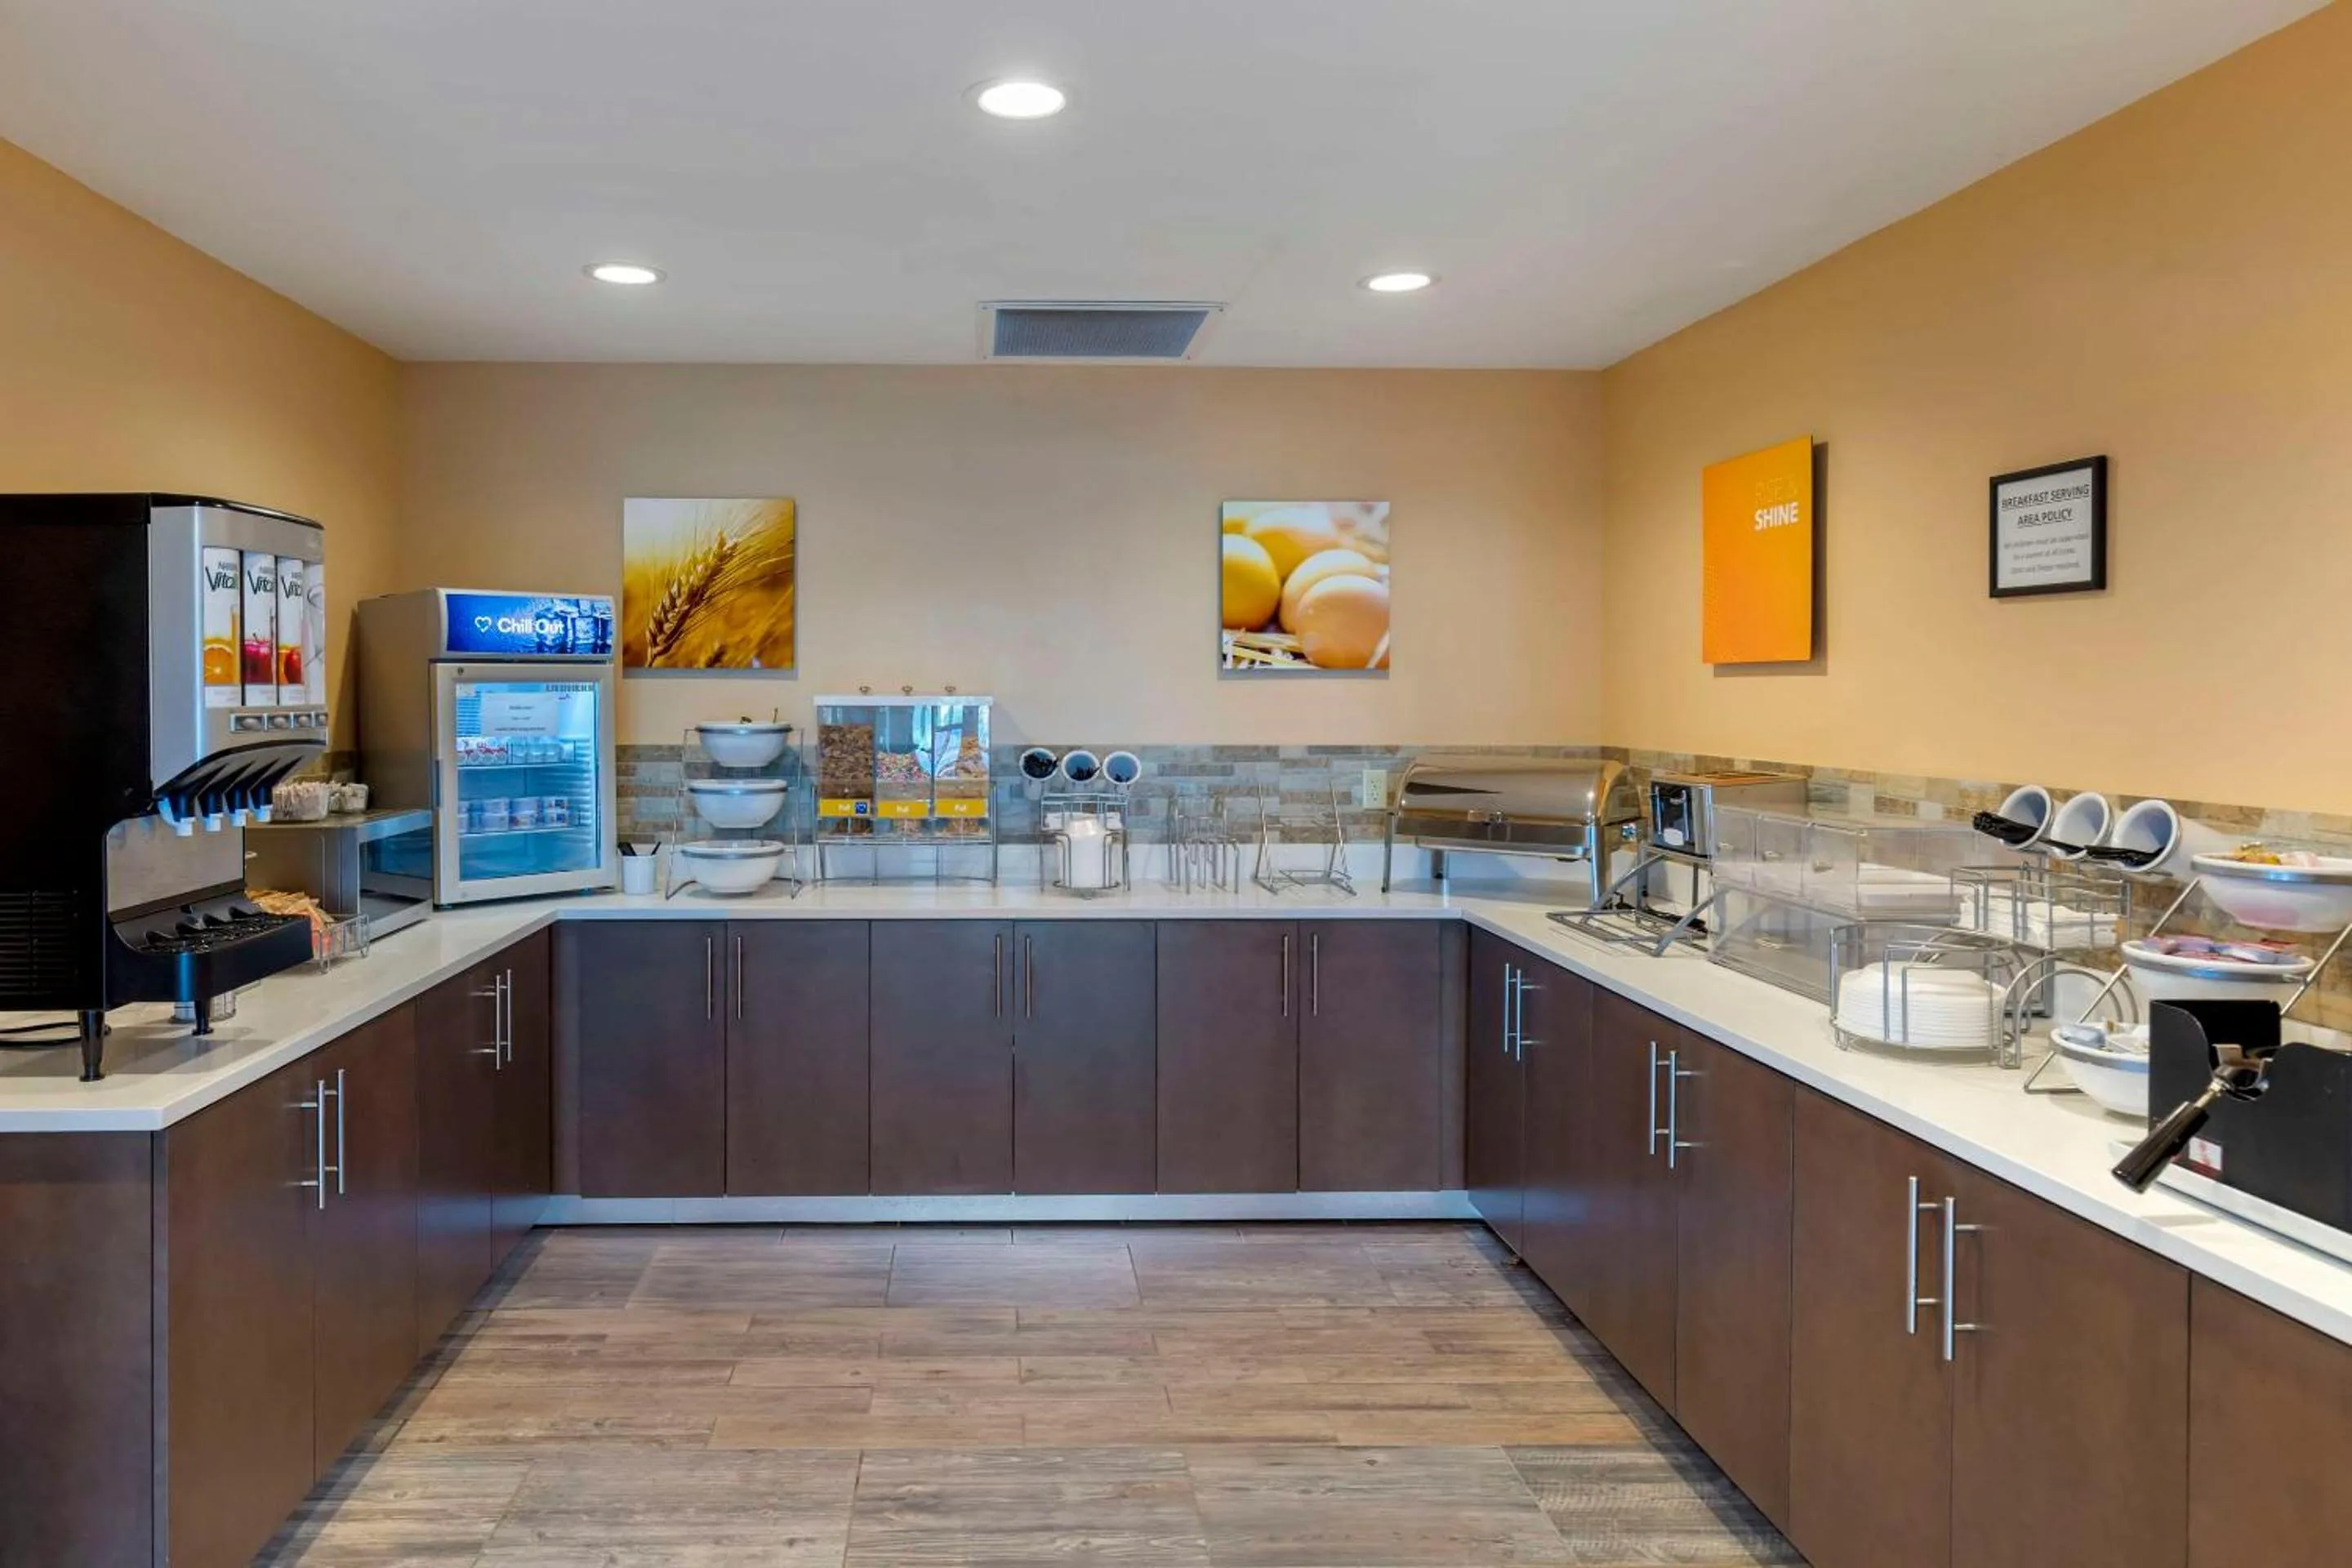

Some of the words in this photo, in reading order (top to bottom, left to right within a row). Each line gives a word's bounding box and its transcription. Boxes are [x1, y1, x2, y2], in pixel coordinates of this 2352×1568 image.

[2002, 491, 2049, 508] BREAKFAST
[2051, 484, 2090, 502] SERVING
[1754, 501, 1799, 531] SHINE
[2017, 514, 2040, 526] AREA
[2042, 507, 2073, 522] POLICY
[497, 617, 532, 634] Chill
[536, 619, 564, 634] Out
